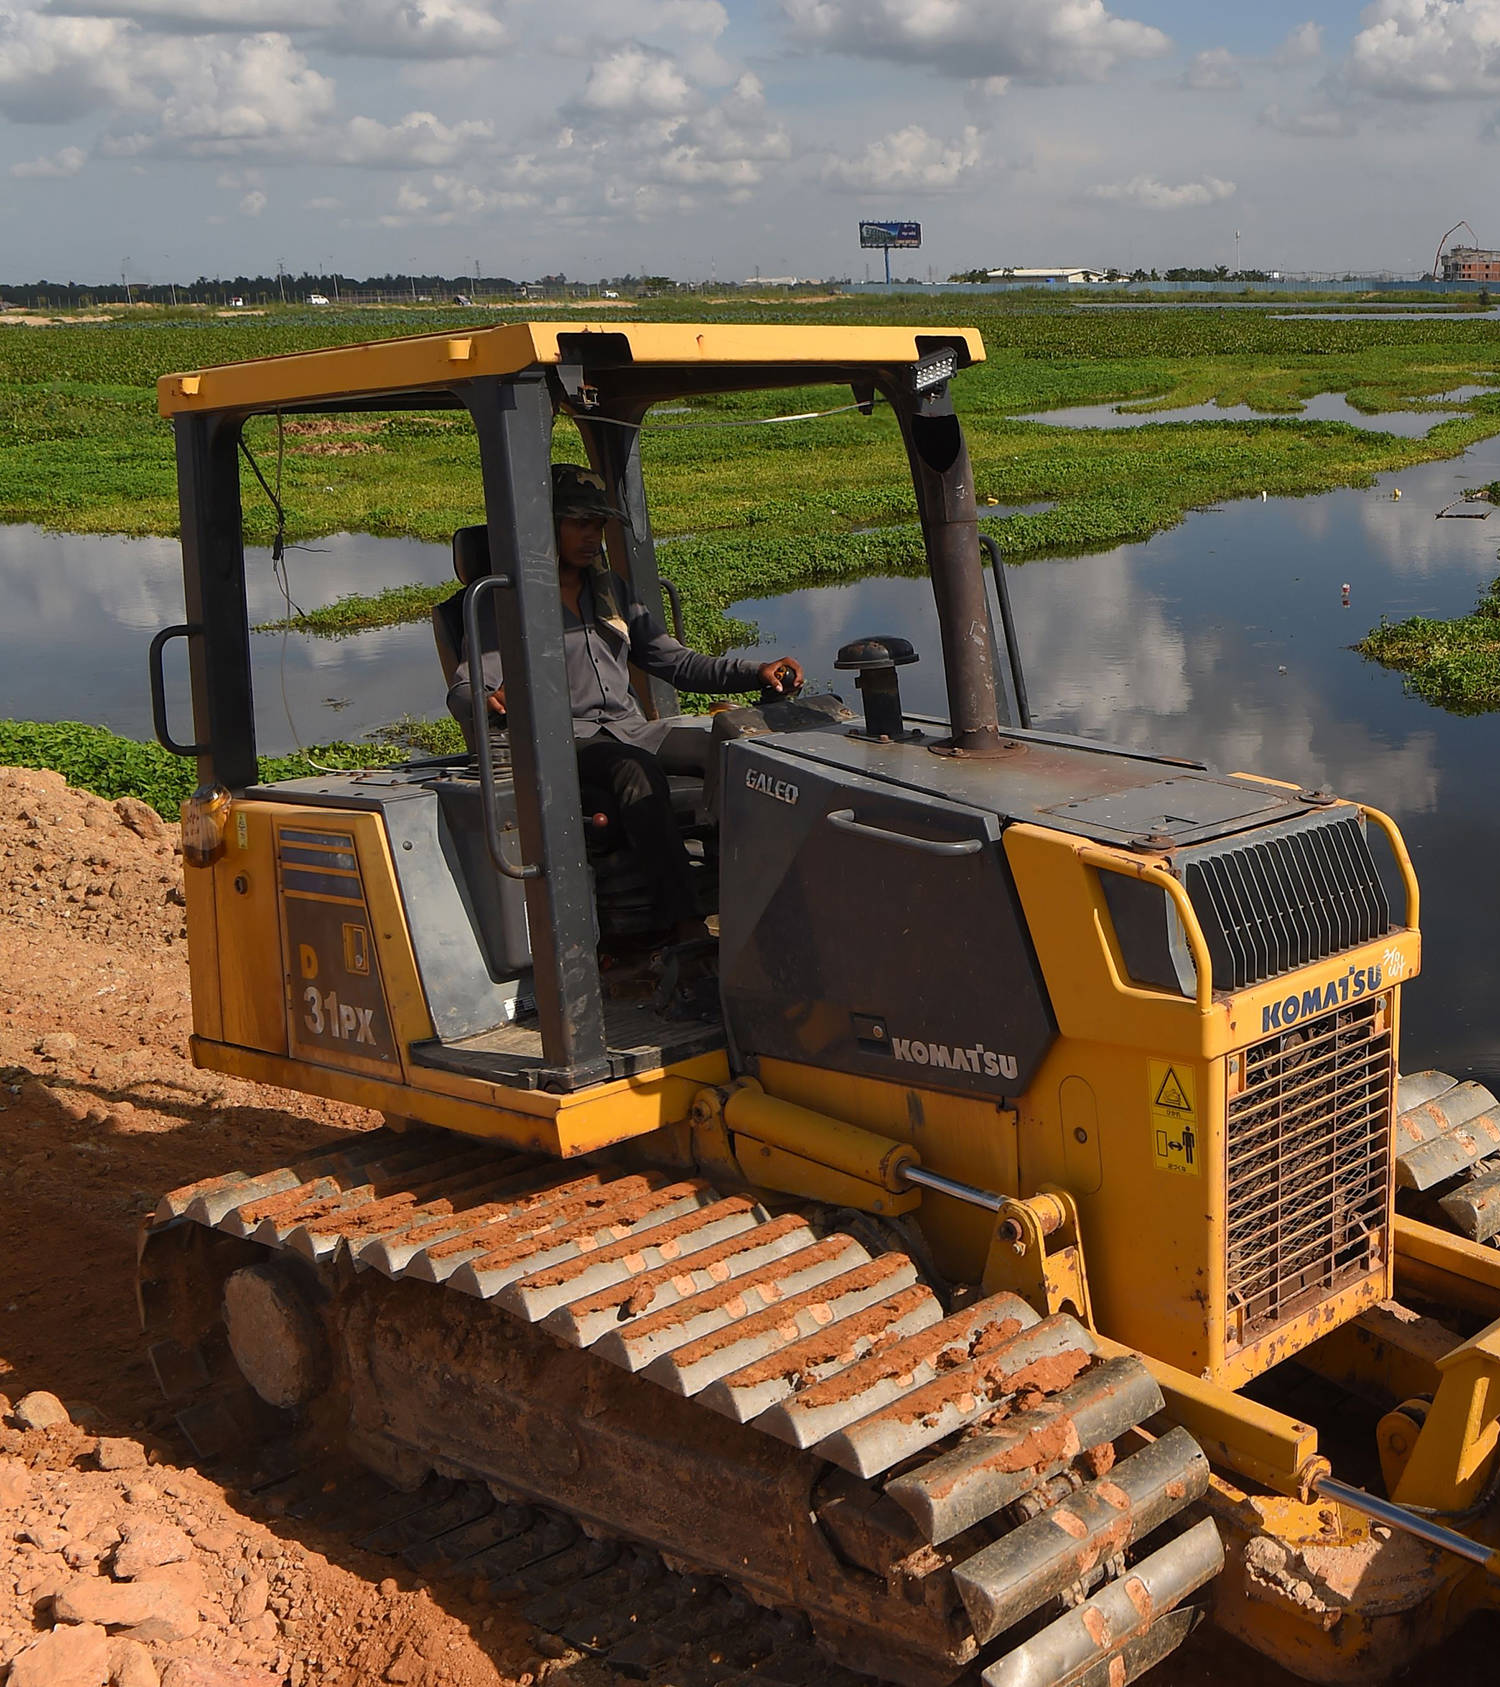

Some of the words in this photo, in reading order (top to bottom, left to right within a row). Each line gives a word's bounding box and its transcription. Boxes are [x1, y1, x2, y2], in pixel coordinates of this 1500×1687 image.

[745, 768, 799, 805] GALEO
[299, 944, 319, 979] D
[304, 986, 377, 1046] 31PX
[1262, 964, 1383, 1034] KOMATSU
[891, 1037, 1019, 1080] KOMATSU
